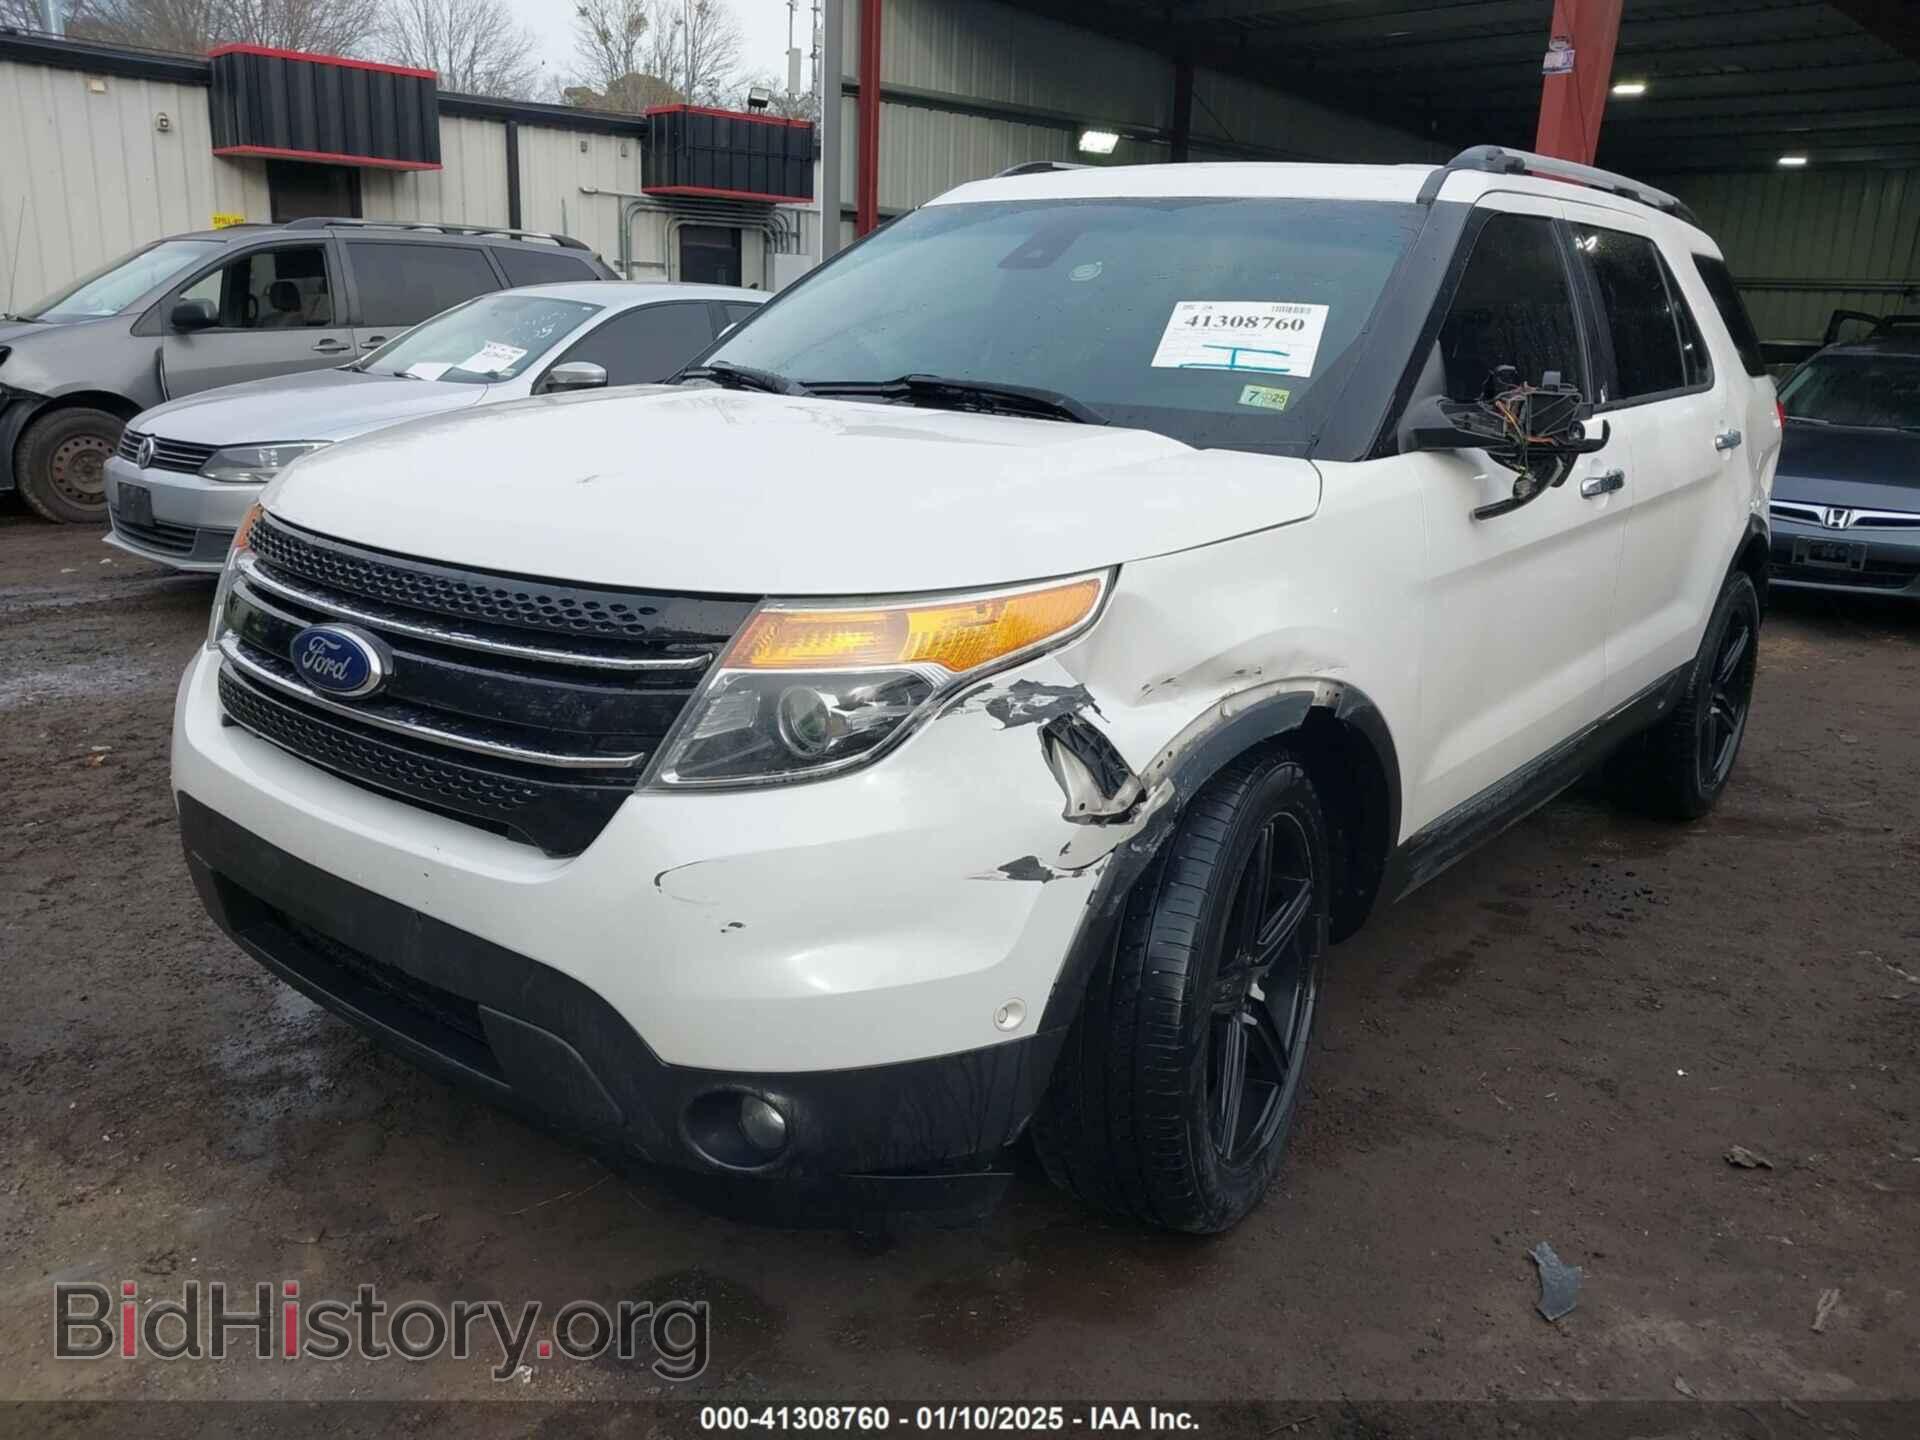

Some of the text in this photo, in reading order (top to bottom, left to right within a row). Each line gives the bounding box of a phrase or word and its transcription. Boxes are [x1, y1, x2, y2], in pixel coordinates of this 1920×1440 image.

[1183, 314, 1305, 332] 41308760
[1248, 390, 1261, 402] 7
[301, 635, 353, 680] Ford
